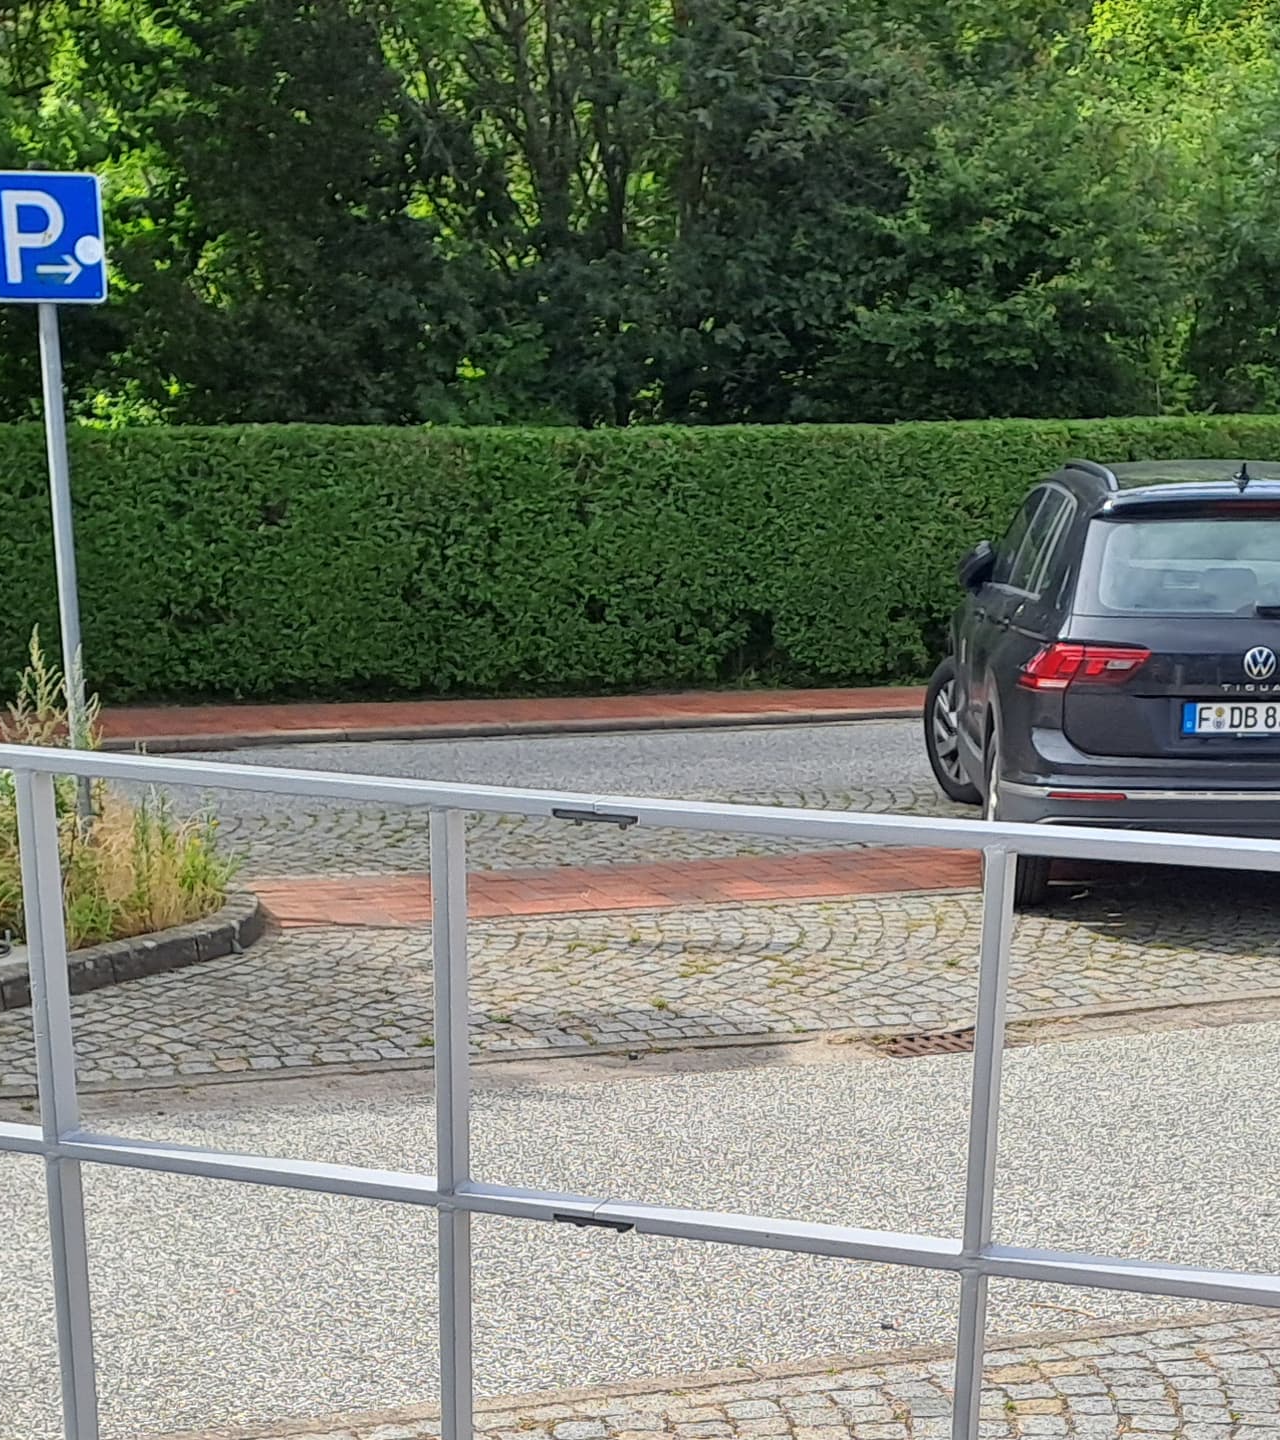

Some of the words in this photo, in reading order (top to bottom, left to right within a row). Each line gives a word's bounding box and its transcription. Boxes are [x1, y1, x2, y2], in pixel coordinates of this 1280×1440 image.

[0, 189, 65, 284] P
[1198, 706, 1213, 729] F
[1229, 706, 1258, 729] DB
